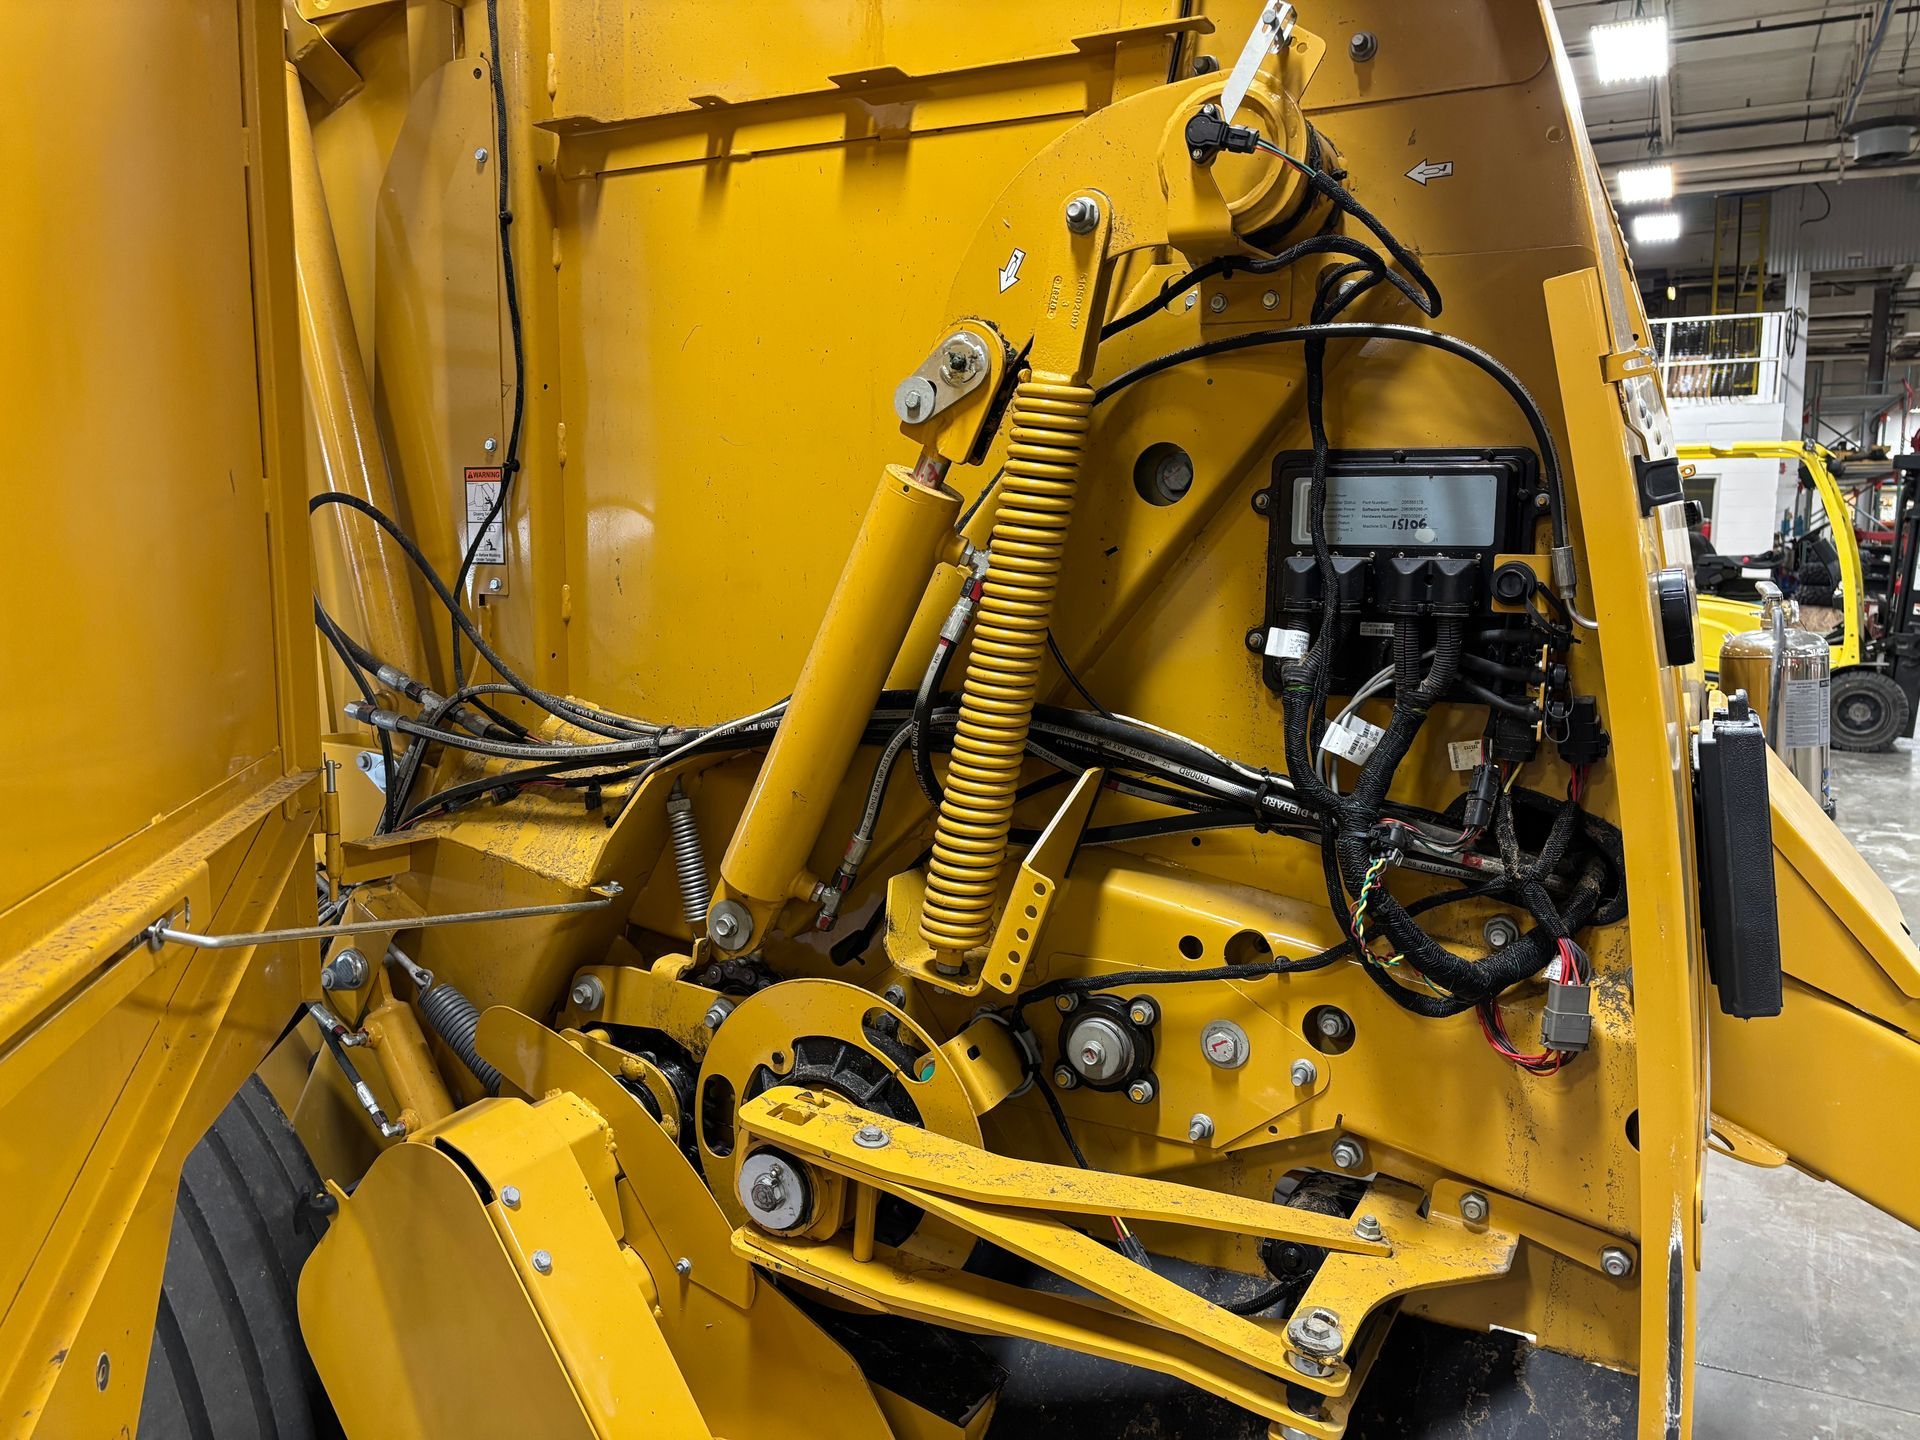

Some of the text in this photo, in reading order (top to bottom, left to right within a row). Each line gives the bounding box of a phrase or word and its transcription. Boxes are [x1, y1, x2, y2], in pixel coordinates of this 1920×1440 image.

[473, 471, 500, 480] WARNING
[1391, 517, 1428, 531] 15106
[911, 721, 921, 747] T3000
[1113, 743, 1127, 753] MAX
[1129, 747, 1146, 760] DN12
[873, 779, 882, 793] MAX
[886, 745, 897, 759] BAR
[1178, 766, 1211, 786] T3008D
[1420, 862, 1441, 873] DN12
[1444, 867, 1461, 876] MAX
